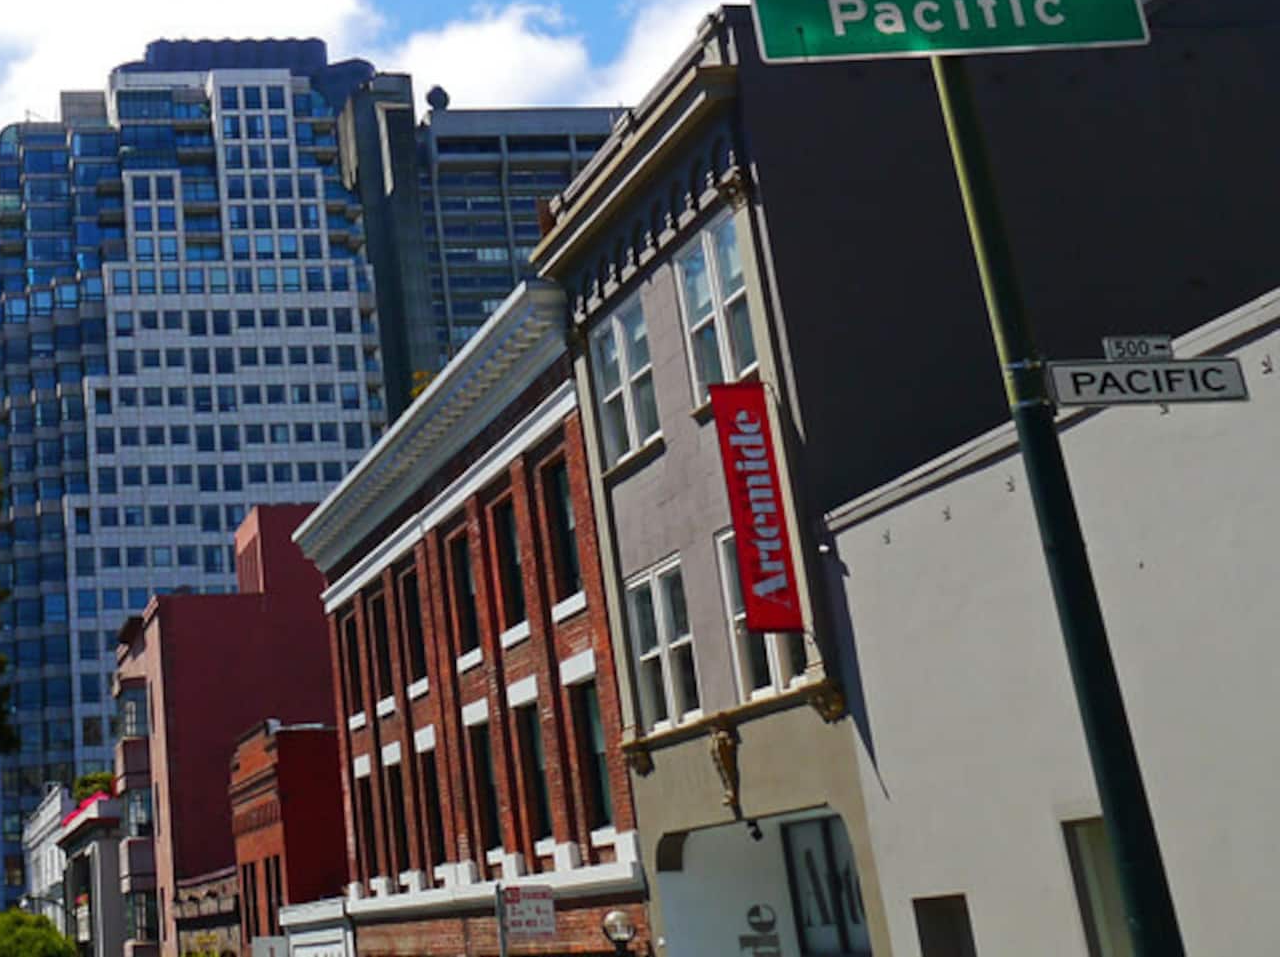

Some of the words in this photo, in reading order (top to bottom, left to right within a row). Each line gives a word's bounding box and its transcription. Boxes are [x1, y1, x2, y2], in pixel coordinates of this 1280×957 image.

[1116, 340, 1150, 357] 500
[1071, 368, 1227, 396] PACIFIC
[729, 409, 792, 610] Artemide
